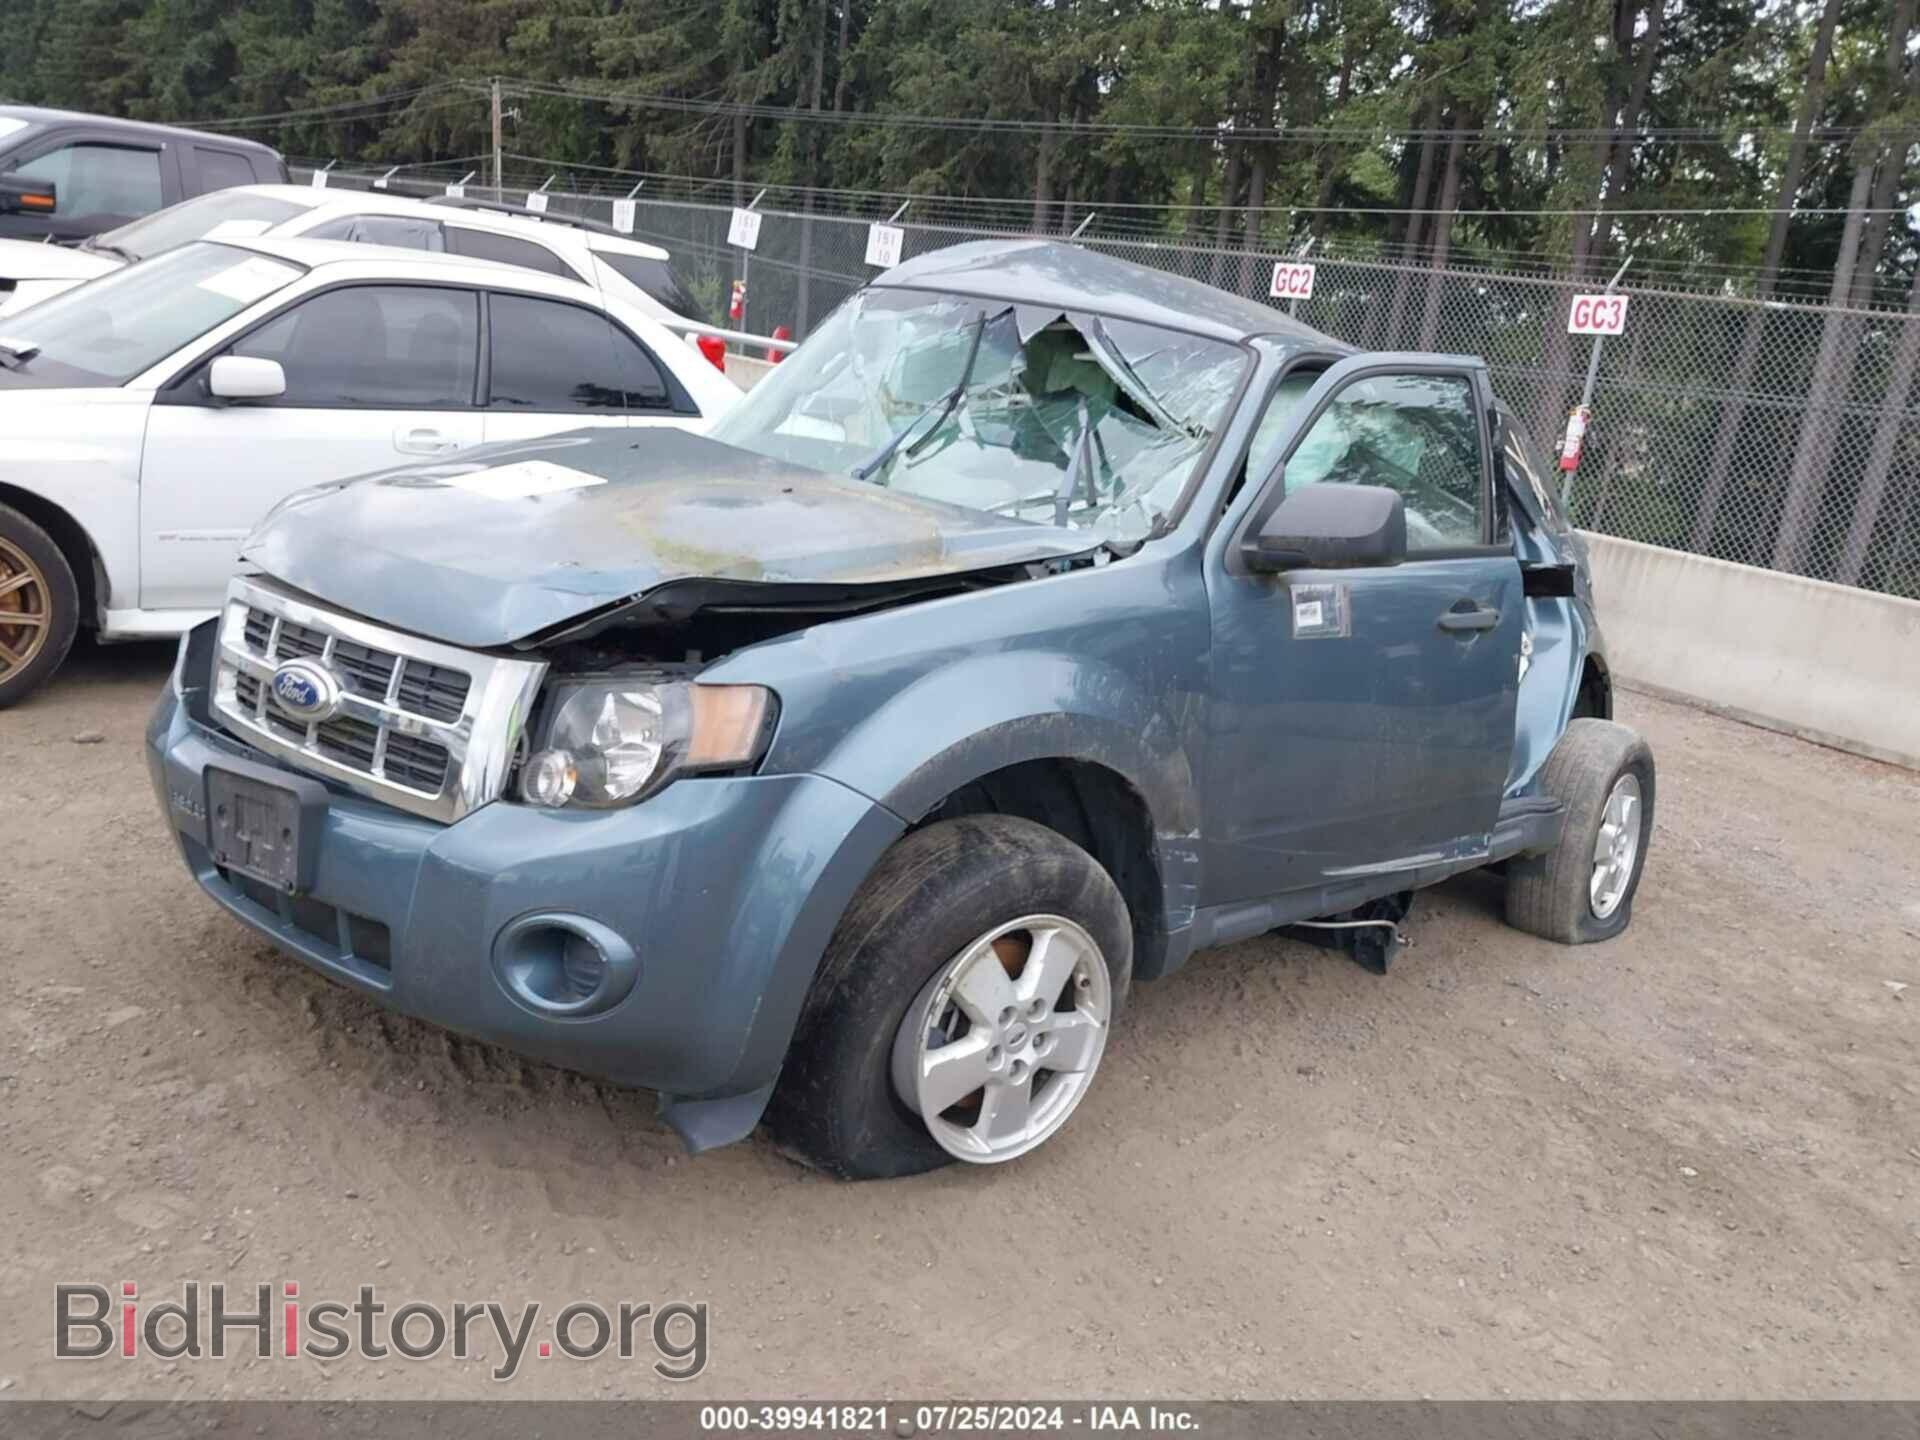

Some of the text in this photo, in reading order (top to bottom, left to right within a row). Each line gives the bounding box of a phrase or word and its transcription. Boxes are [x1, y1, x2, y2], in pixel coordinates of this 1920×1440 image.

[1275, 267, 1311, 294] GC2
[1574, 299, 1622, 329] GC3
[279, 673, 310, 704] Ford
